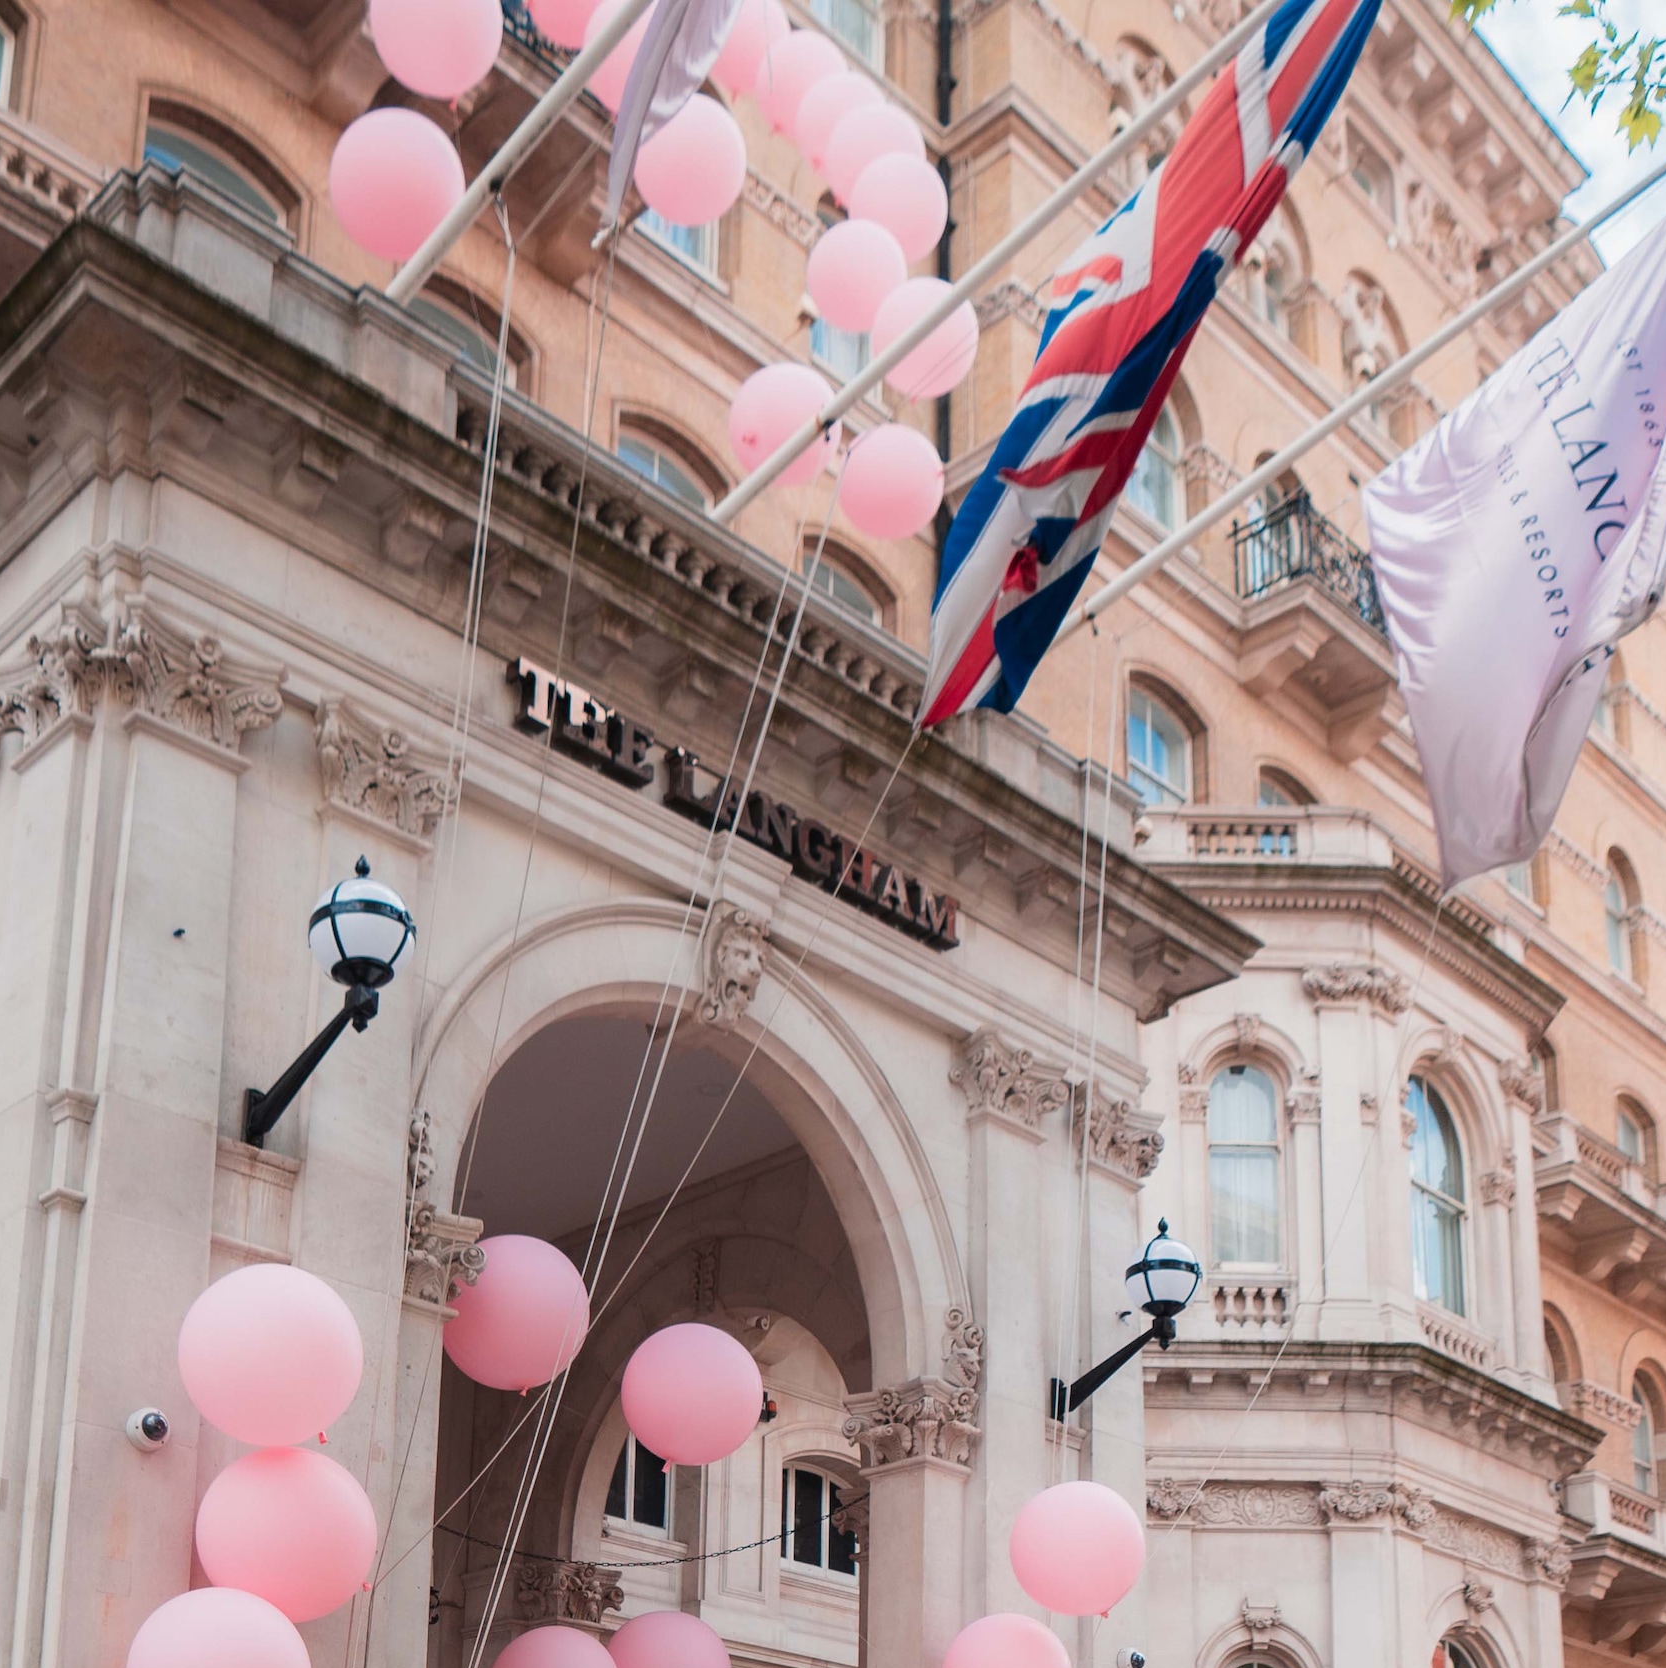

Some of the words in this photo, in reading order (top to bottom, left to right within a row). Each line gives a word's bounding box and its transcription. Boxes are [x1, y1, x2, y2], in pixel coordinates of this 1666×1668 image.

[1635, 388, 1665, 449] 1865
[1520, 514, 1570, 639] RESORTS
[507, 656, 655, 790] THE
[663, 745, 962, 952] LANGHAM
